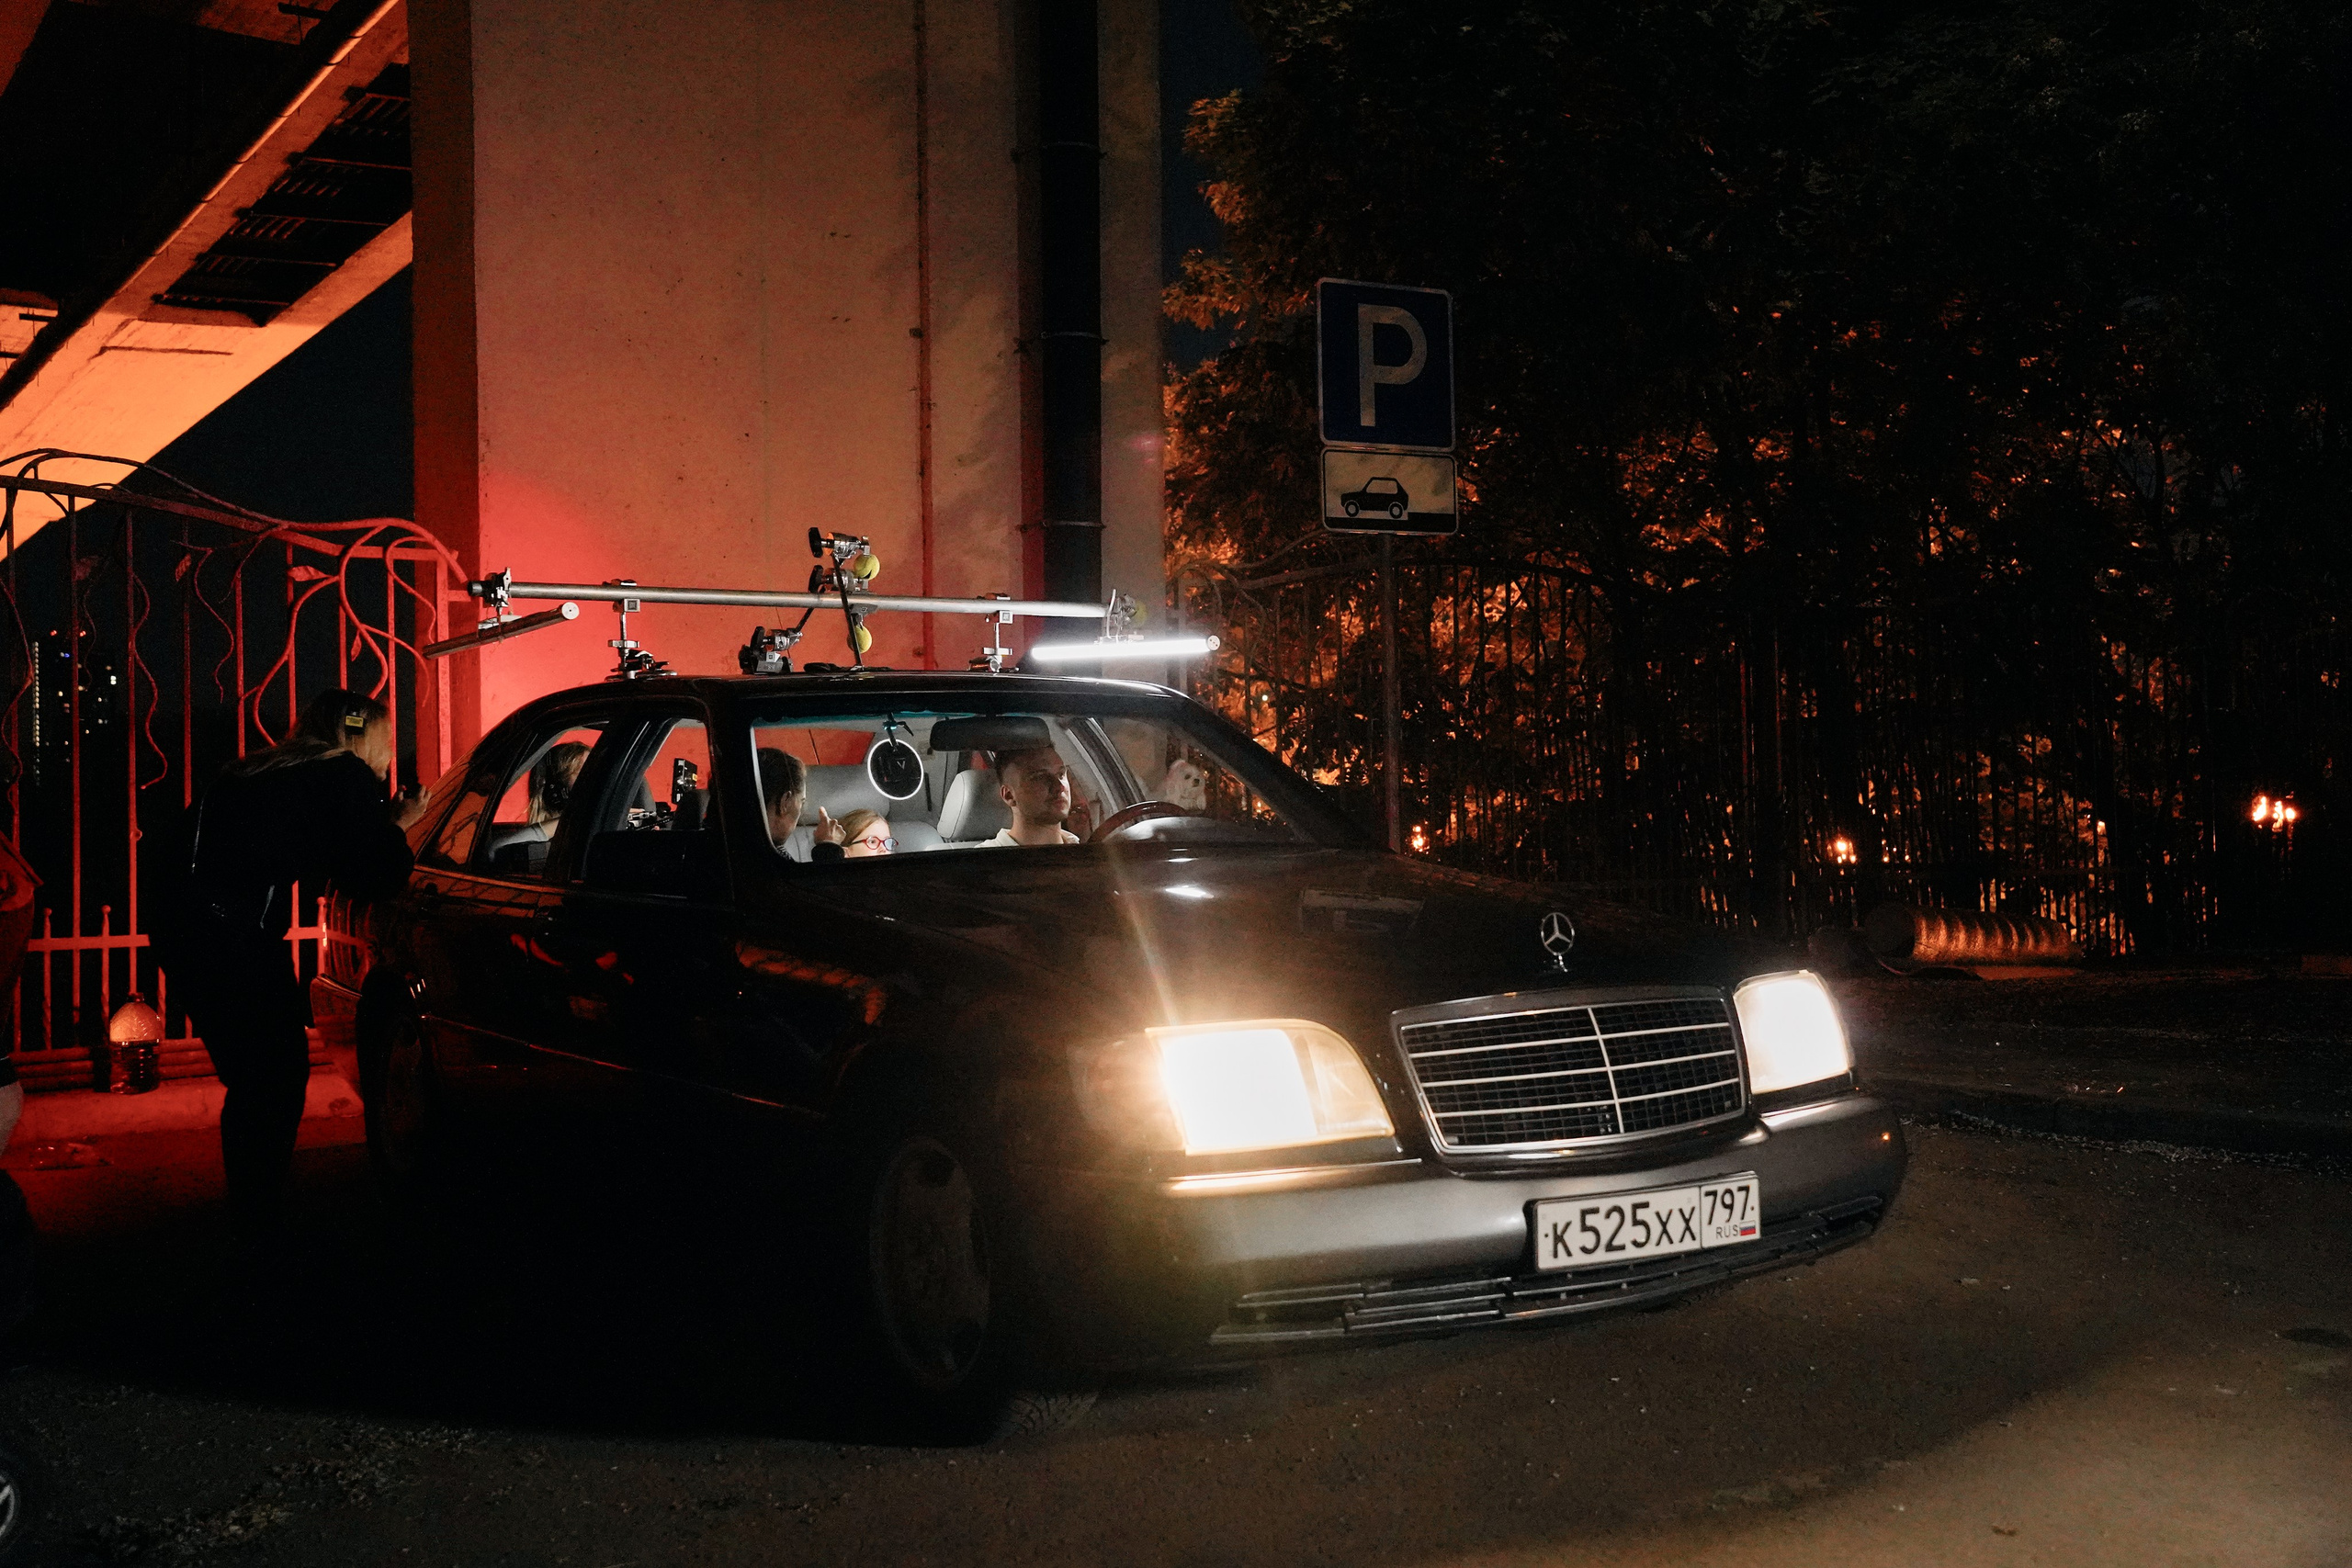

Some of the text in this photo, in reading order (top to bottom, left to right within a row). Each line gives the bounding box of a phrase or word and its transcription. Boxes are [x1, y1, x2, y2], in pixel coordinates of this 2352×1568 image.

[1357, 303, 1428, 427] P
[1703, 1185, 1751, 1225] 797
[1715, 1224, 1739, 1239] RUS
